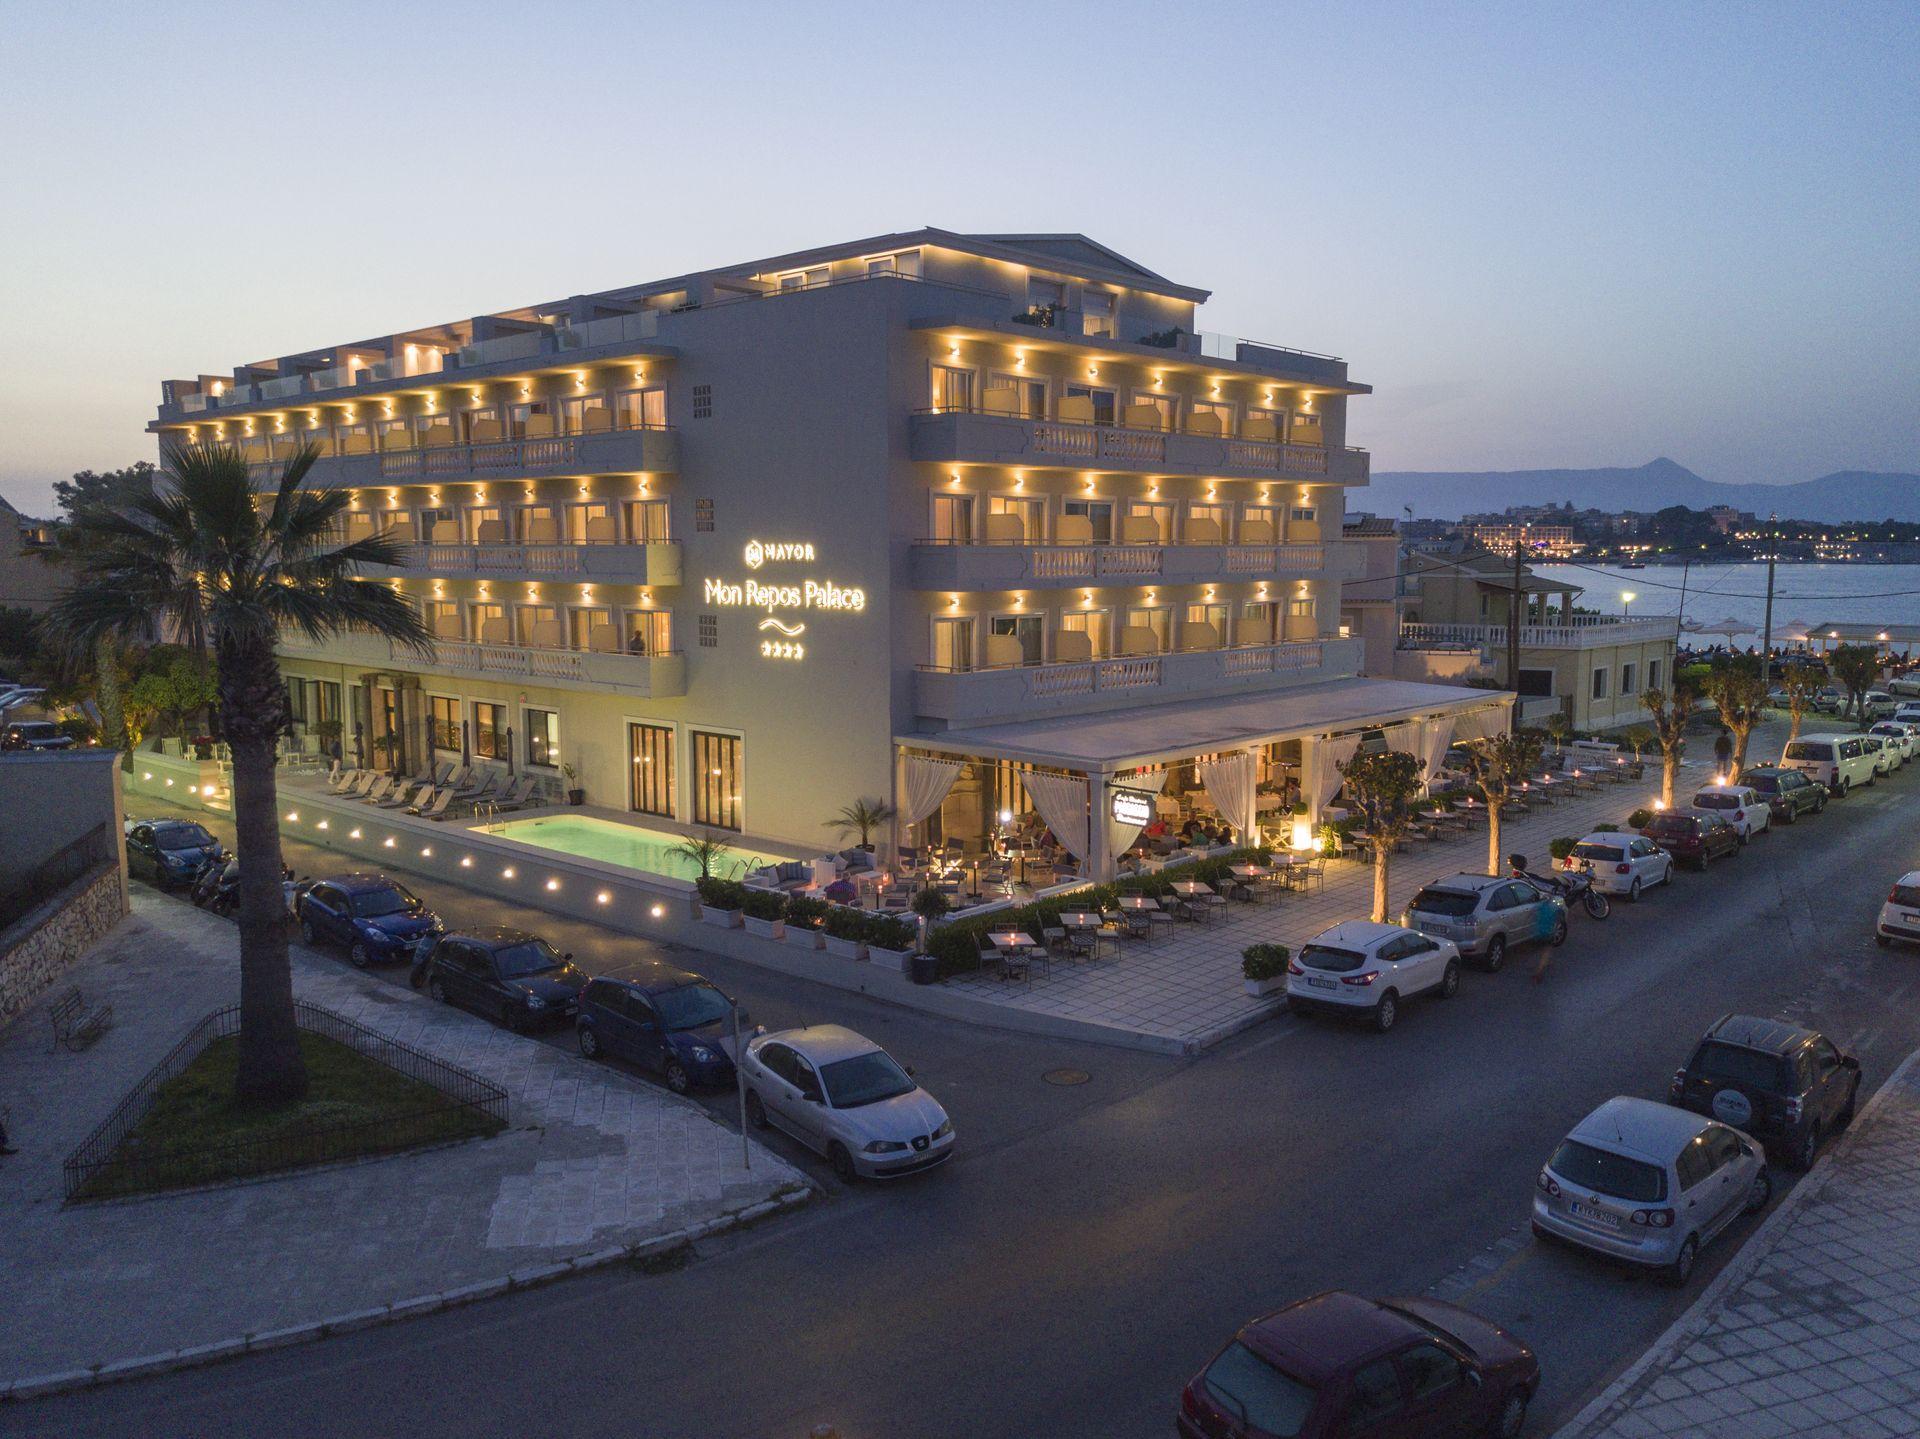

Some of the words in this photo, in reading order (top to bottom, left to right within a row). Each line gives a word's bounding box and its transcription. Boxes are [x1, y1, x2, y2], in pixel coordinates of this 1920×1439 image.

[764, 542, 815, 562] MAYOR
[704, 578, 742, 606] Mon
[745, 579, 801, 613] Repos
[804, 580, 866, 611] Palace
